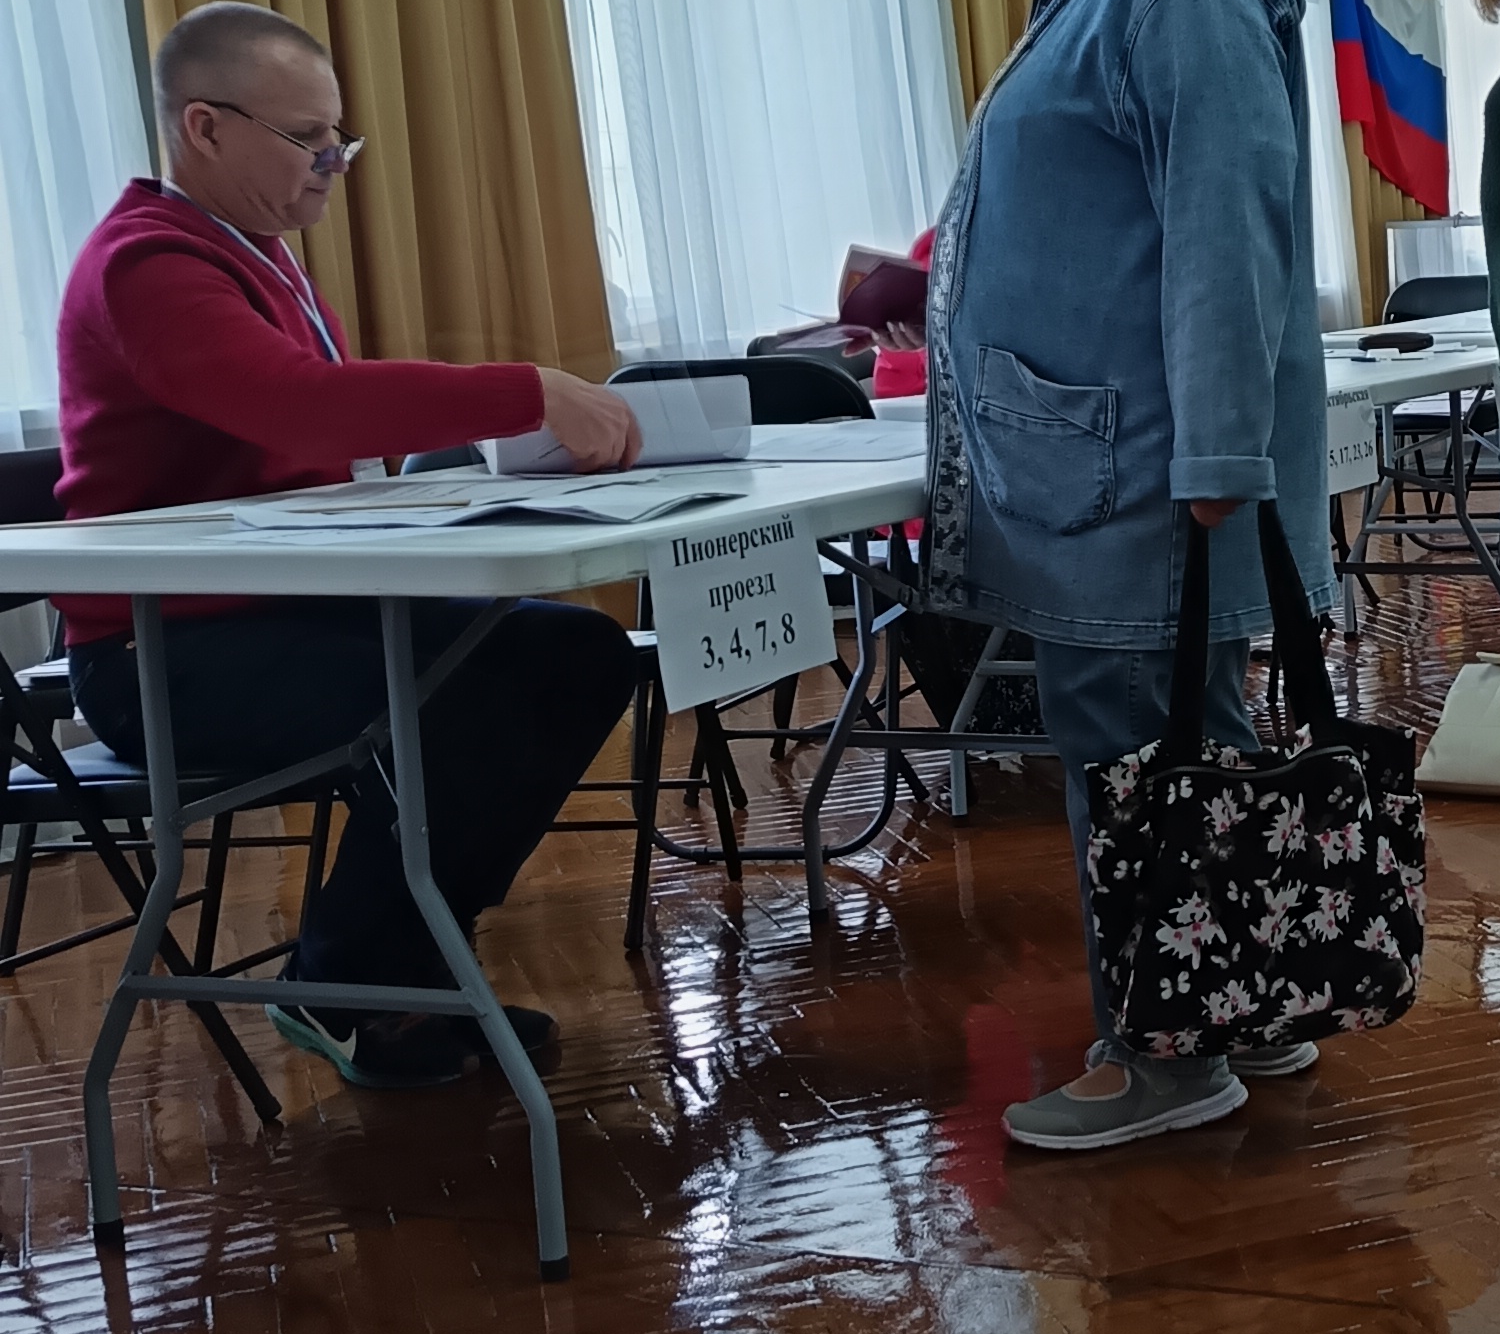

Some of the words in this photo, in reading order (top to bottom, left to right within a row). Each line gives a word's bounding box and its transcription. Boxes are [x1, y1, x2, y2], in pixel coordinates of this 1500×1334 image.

[1326, 389, 1369, 409] ктябрьская
[671, 514, 795, 568] Пионерский
[708, 572, 776, 612] проезд
[701, 635, 725, 673] 3,
[730, 627, 752, 664] 4,
[755, 619, 778, 656] 7,
[781, 612, 796, 645] 8
